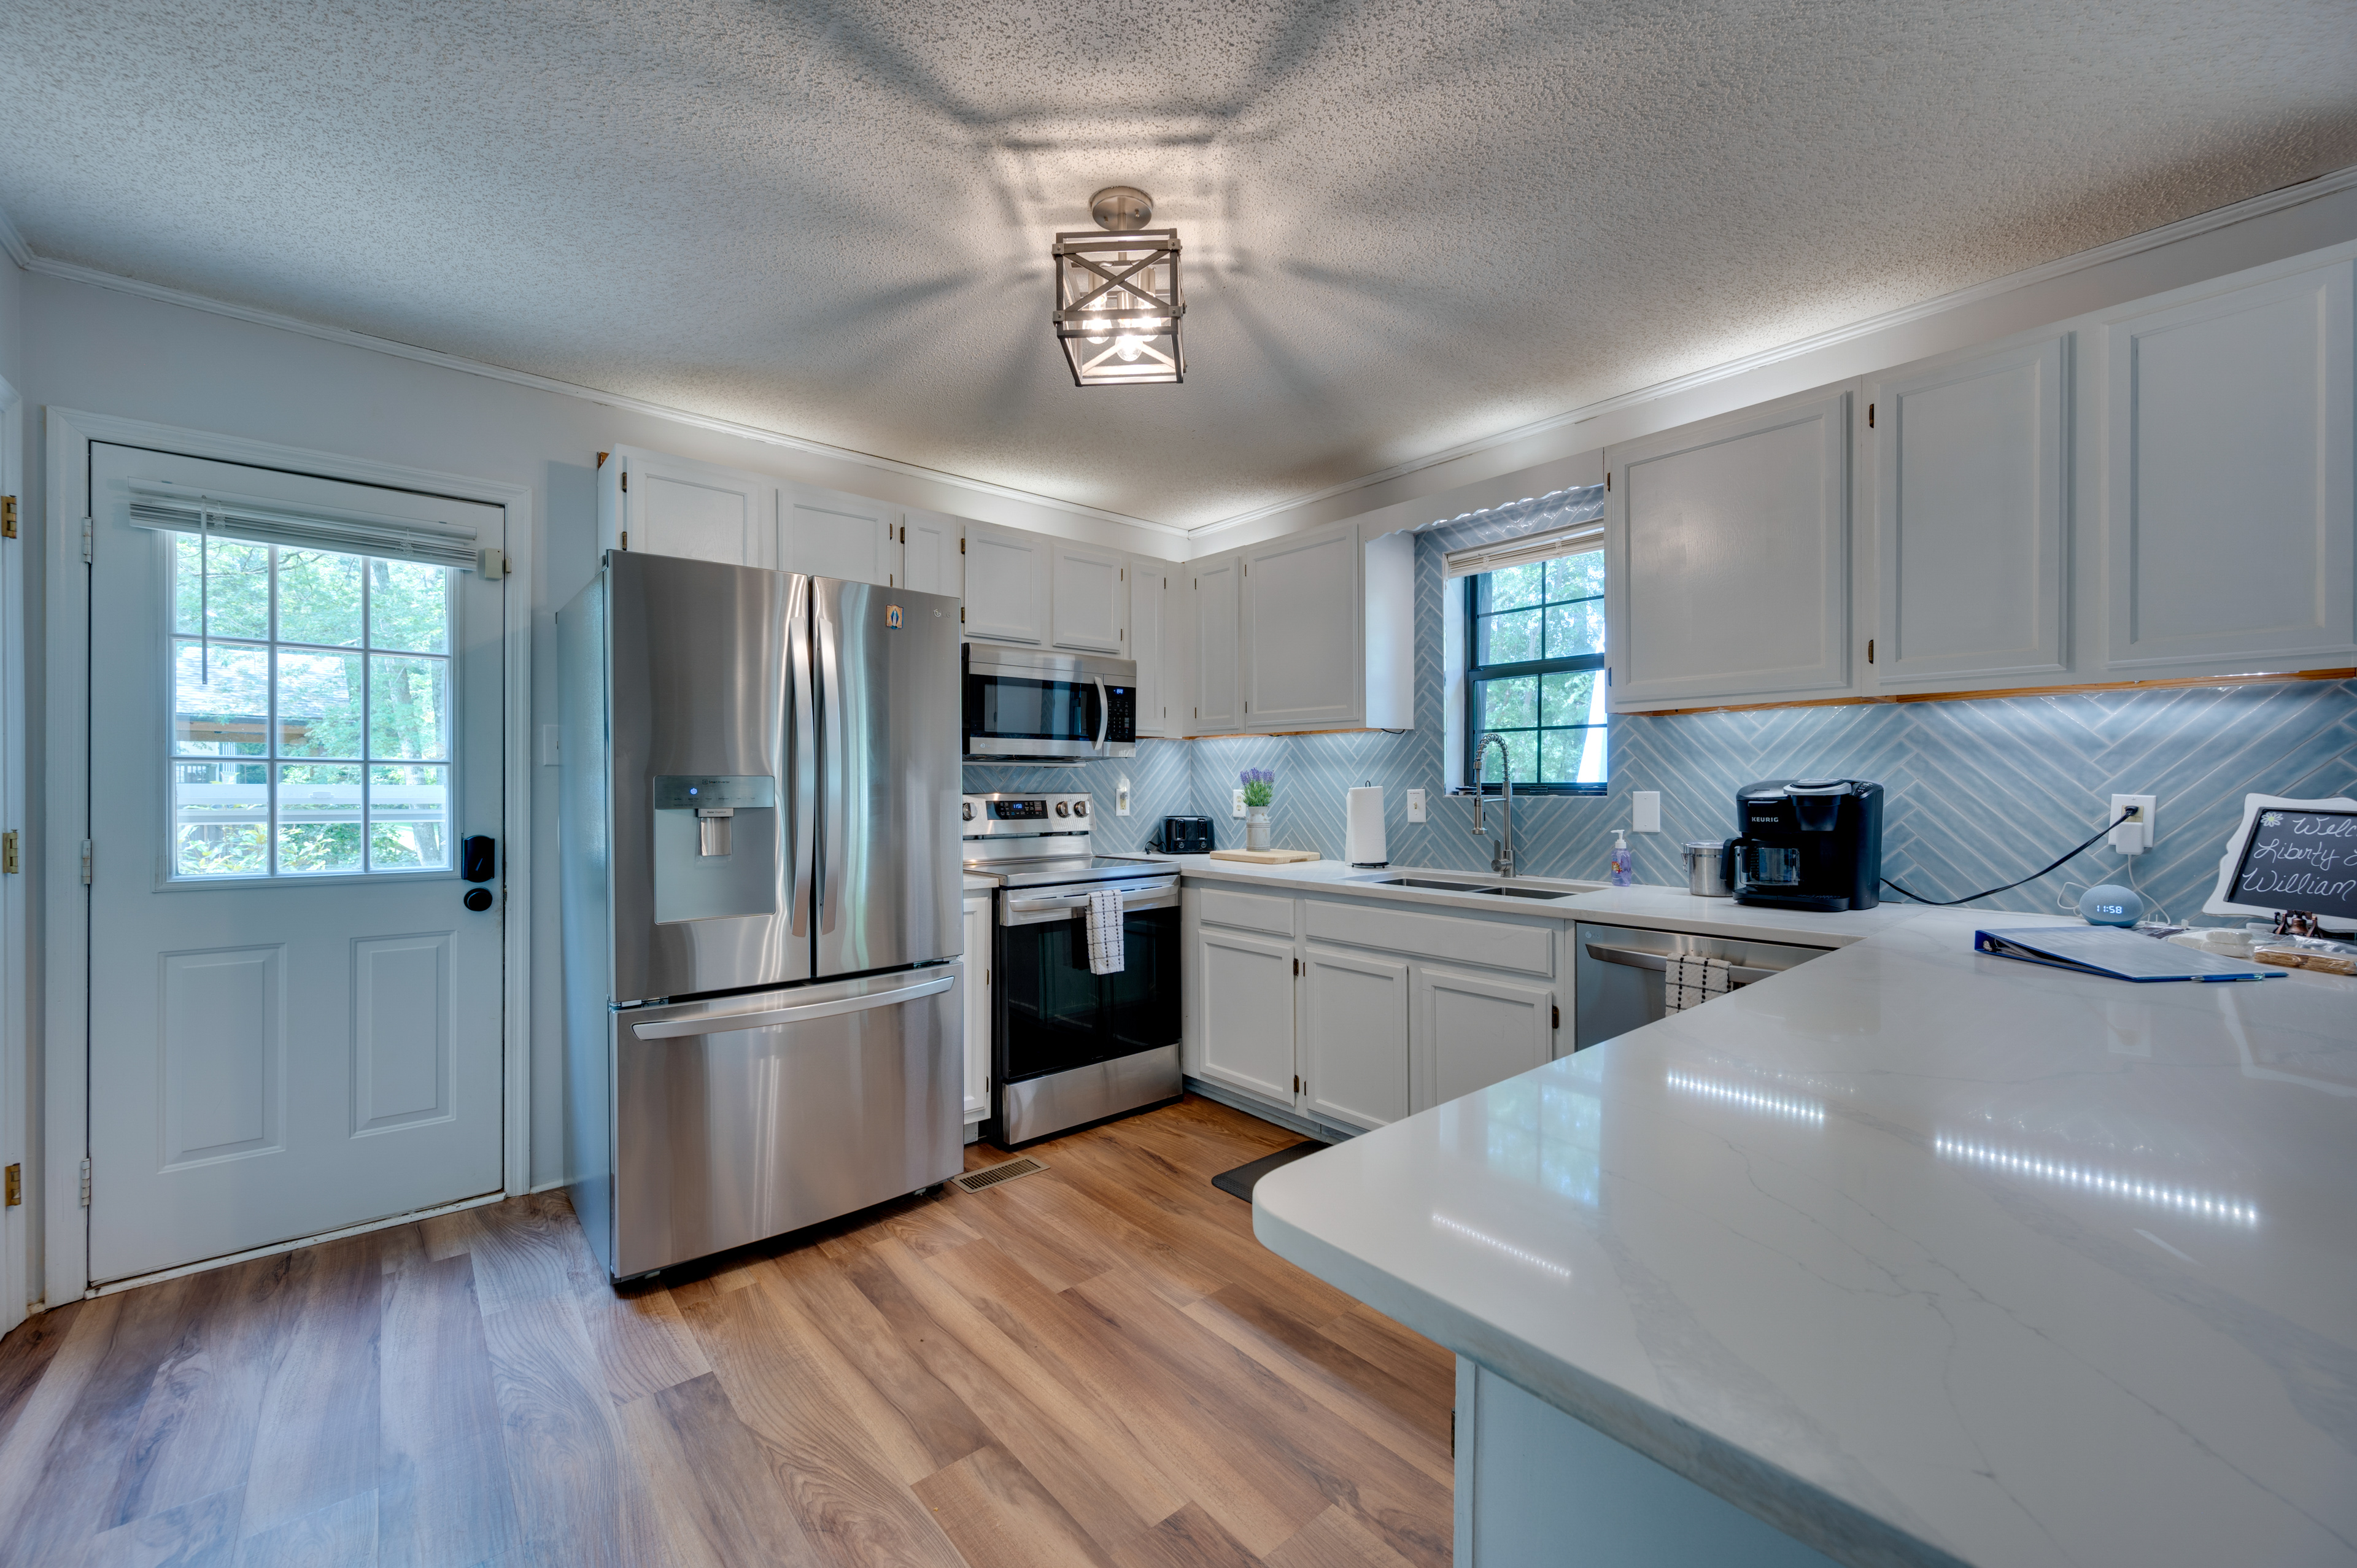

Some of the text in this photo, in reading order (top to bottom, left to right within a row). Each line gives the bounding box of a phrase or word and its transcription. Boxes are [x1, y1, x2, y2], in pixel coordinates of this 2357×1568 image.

[2293, 817, 2357, 837] Welc
[2253, 838, 2340, 871] Liberty
[2097, 905, 2123, 914] 11:58
